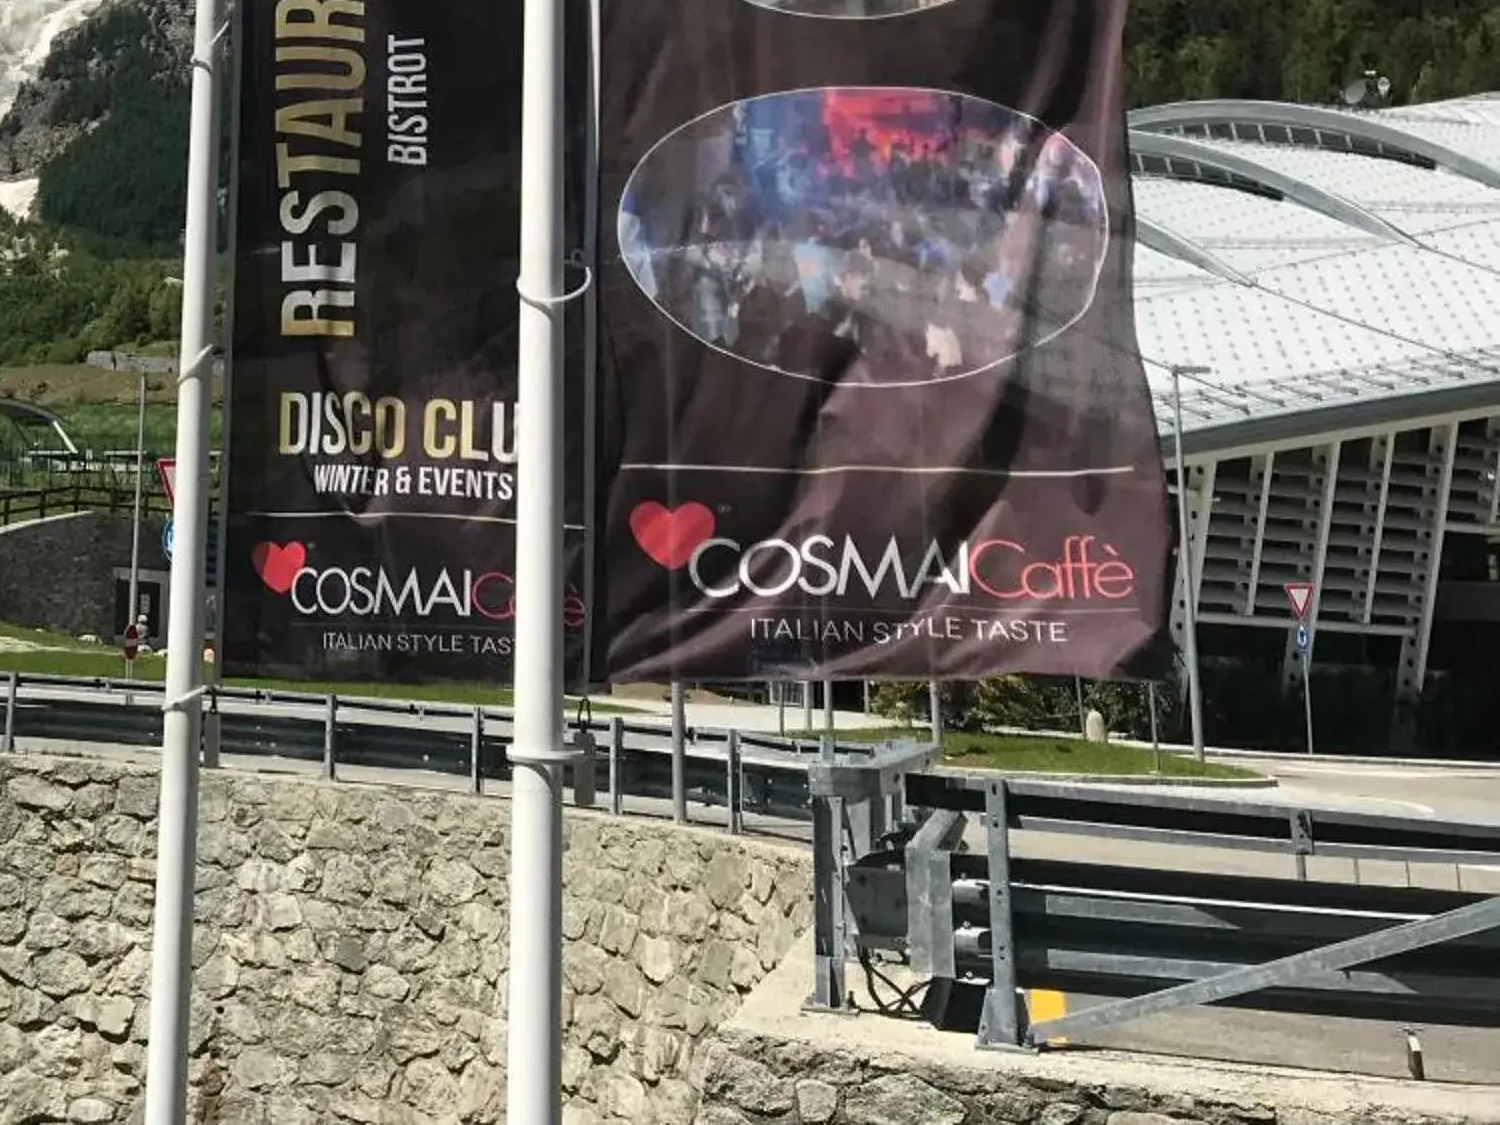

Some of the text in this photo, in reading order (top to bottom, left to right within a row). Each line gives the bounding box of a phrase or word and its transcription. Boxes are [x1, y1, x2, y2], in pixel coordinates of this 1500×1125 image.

[387, 34, 428, 167] BISTROT
[278, 390, 519, 463] DISCO CLU
[314, 464, 514, 501] WINTER & EVENTS
[323, 631, 517, 655] ITALIAN STYLE TAS
[749, 614, 1068, 645] ITALIAN STYLE TASTE
